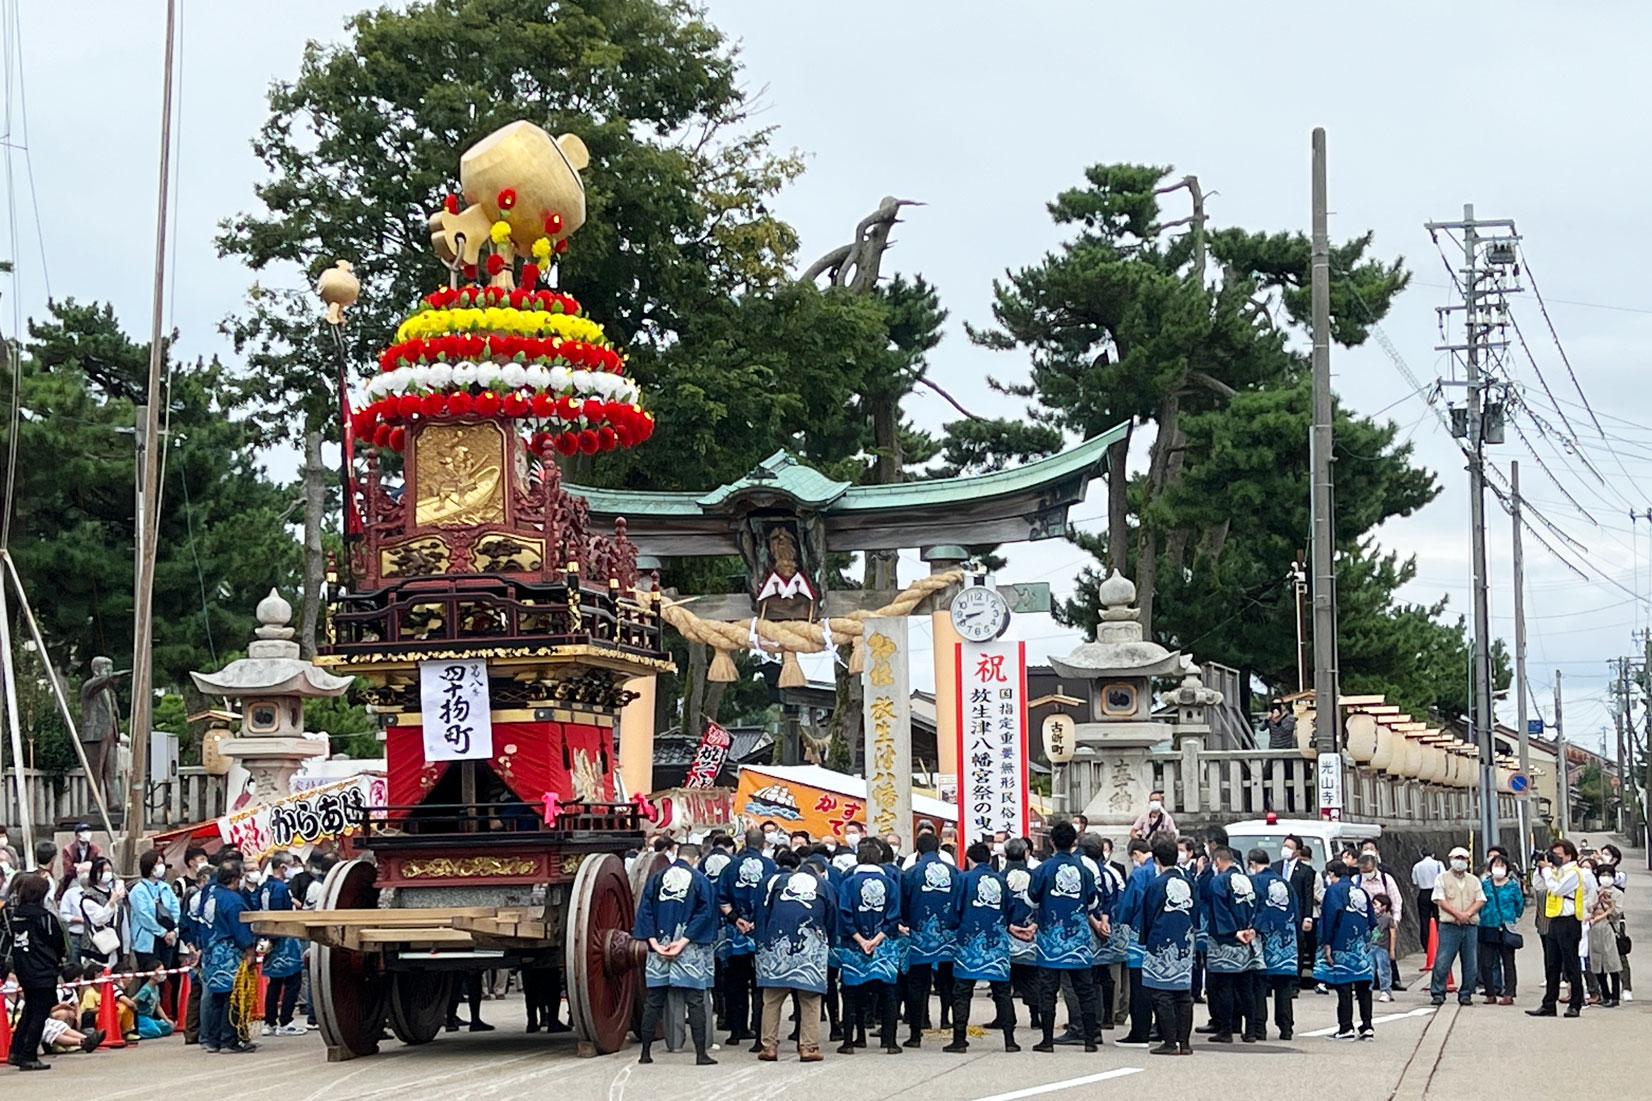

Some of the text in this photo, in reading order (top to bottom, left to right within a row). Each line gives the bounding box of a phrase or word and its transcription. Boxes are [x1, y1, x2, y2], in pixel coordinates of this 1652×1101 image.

[974, 652, 1008, 683] 祝
[439, 665, 474, 755] 四十物町
[1051, 721, 1064, 755] 古新町
[1108, 759, 1136, 814] 奉納
[1320, 760, 1335, 805] 光山寺
